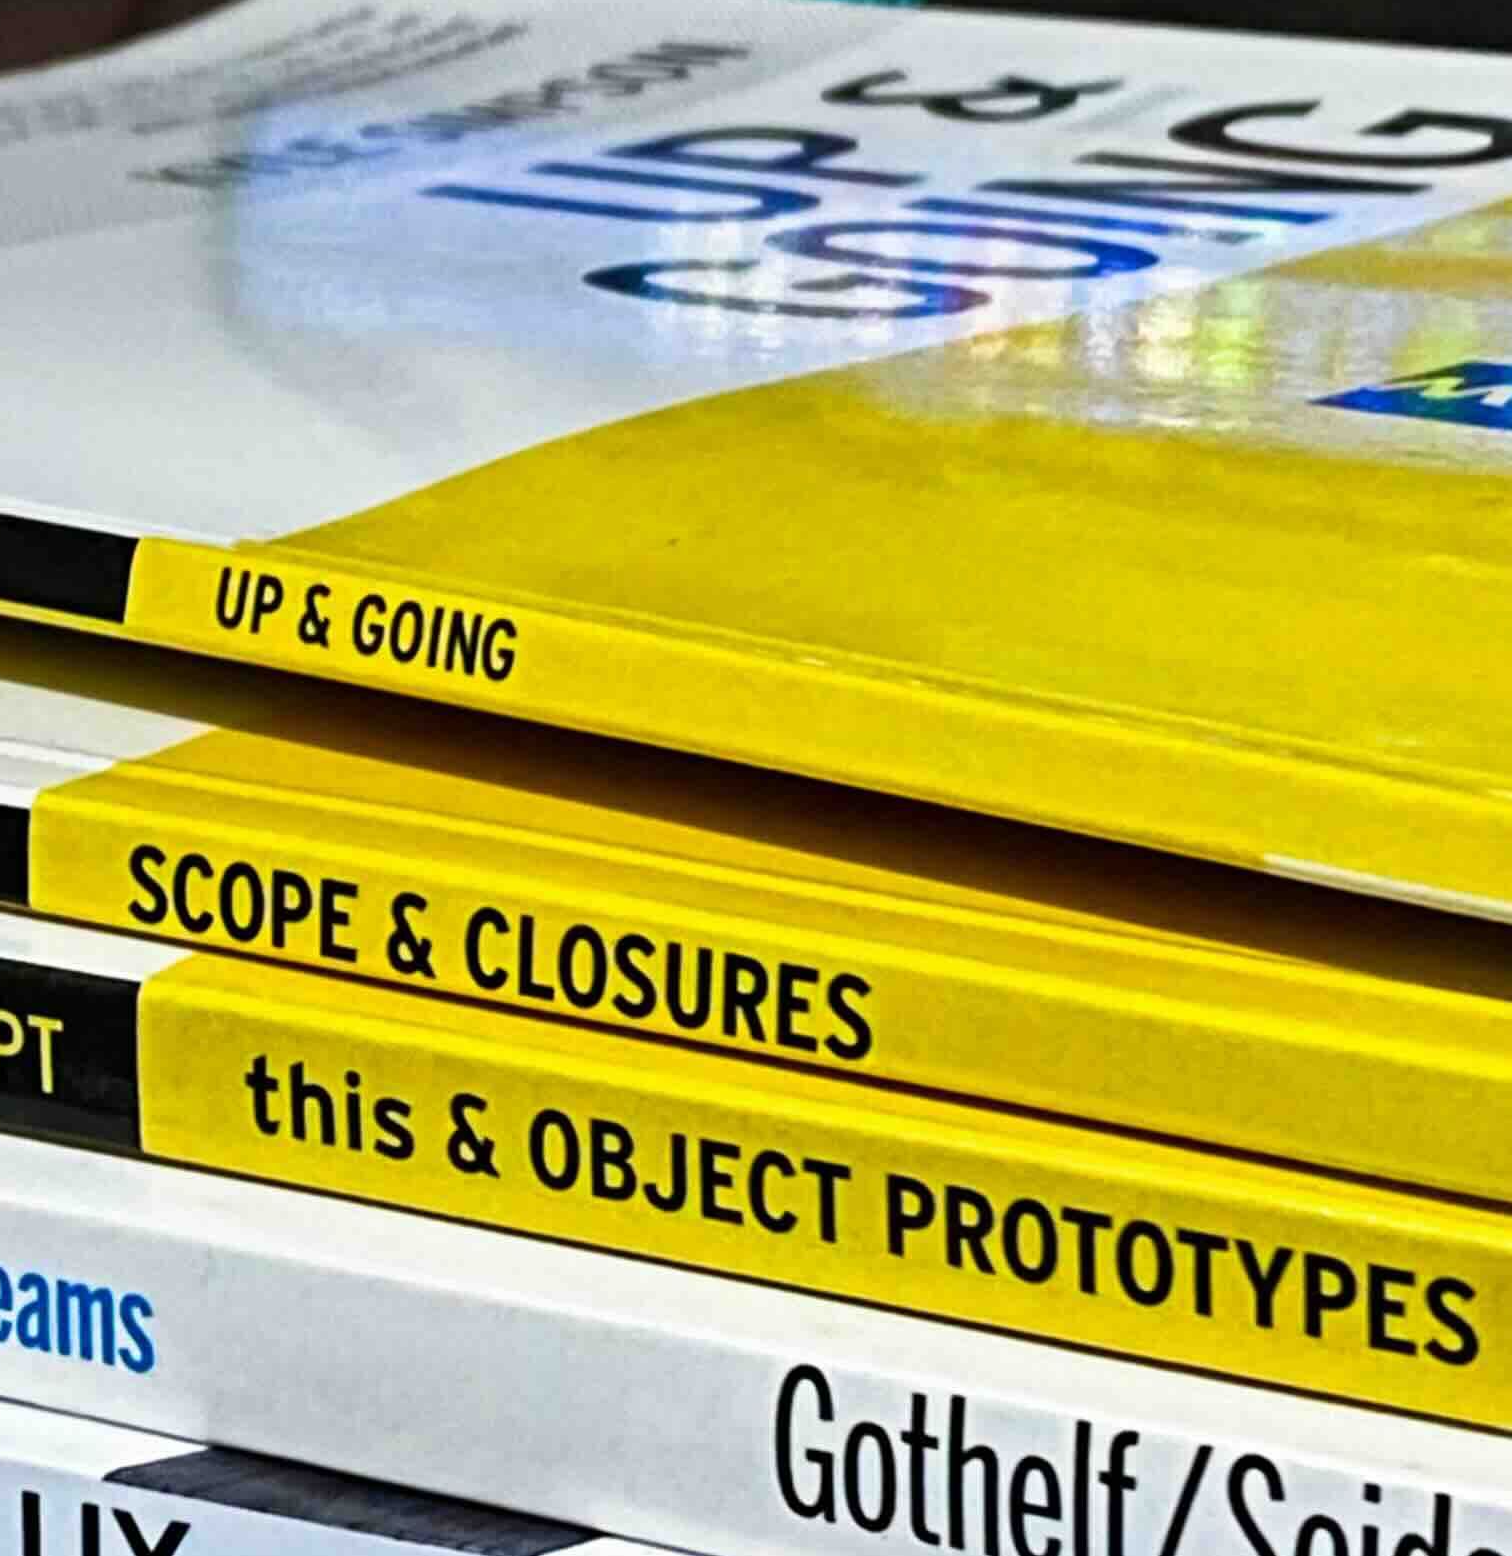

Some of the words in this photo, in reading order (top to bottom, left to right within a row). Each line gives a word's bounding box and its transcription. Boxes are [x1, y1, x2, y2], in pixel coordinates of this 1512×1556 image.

[416, 123, 926, 226] UP
[214, 566, 285, 636] UP
[298, 586, 331, 645] &
[351, 596, 518, 683] GOING
[128, 843, 360, 965] SCOPE
[389, 891, 434, 979] &
[463, 906, 873, 1061] CLOSURES
[246, 1052, 416, 1158] this
[445, 1093, 501, 1178] &
[527, 1107, 853, 1244] OBJECT
[885, 1172, 1480, 1367] PROTOTYPES
